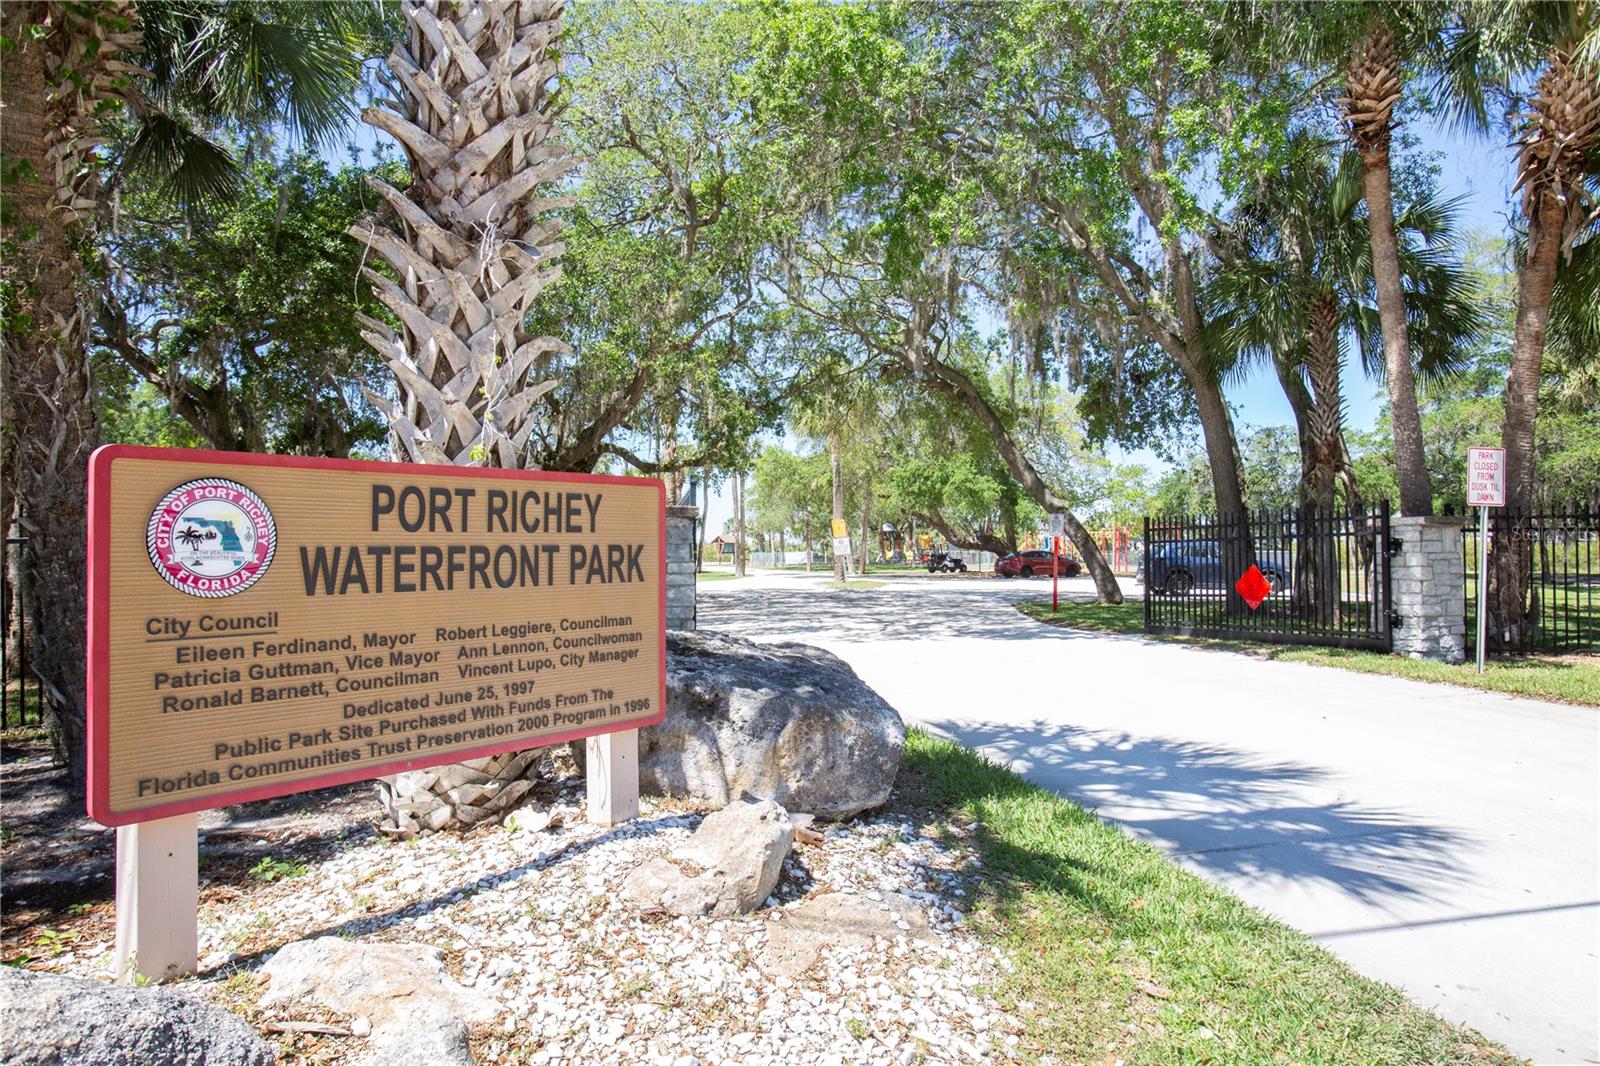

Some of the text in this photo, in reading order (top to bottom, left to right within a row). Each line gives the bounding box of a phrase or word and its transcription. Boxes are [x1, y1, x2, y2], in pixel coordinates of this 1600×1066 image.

[1474, 462, 1499, 471] CLOSED
[1478, 451, 1494, 460] PARK
[1471, 482, 1488, 491] DUSK
[1477, 472, 1495, 481] FROM
[371, 484, 603, 533] PORT RICHEY
[1476, 493, 1494, 501] DAWN
[157, 486, 269, 548] CITY OF PORT RICHEY
[176, 569, 252, 590] FLORIDA
[300, 544, 645, 596] WATERFRONT PARK
[145, 612, 279, 638] City Council
[435, 615, 632, 642] Robert Leggiere, Councilman
[176, 631, 417, 664] Eileen Ferdinand, Mayor
[457, 630, 643, 661] Ann Lennon, Councilwoman
[154, 650, 441, 690] Patricia Guttman, Vice Mayor
[458, 647, 640, 679] Vincent Lupo, City Manager
[162, 669, 439, 714] Ronald Barnett, Councilman
[343, 681, 536, 719] Dedicated June 25, 1997
[214, 688, 615, 761] Public Park Site Purchased With Funds From The
[137, 698, 651, 798] Florida Communities Trust Preservation 2000 Program in 1996
